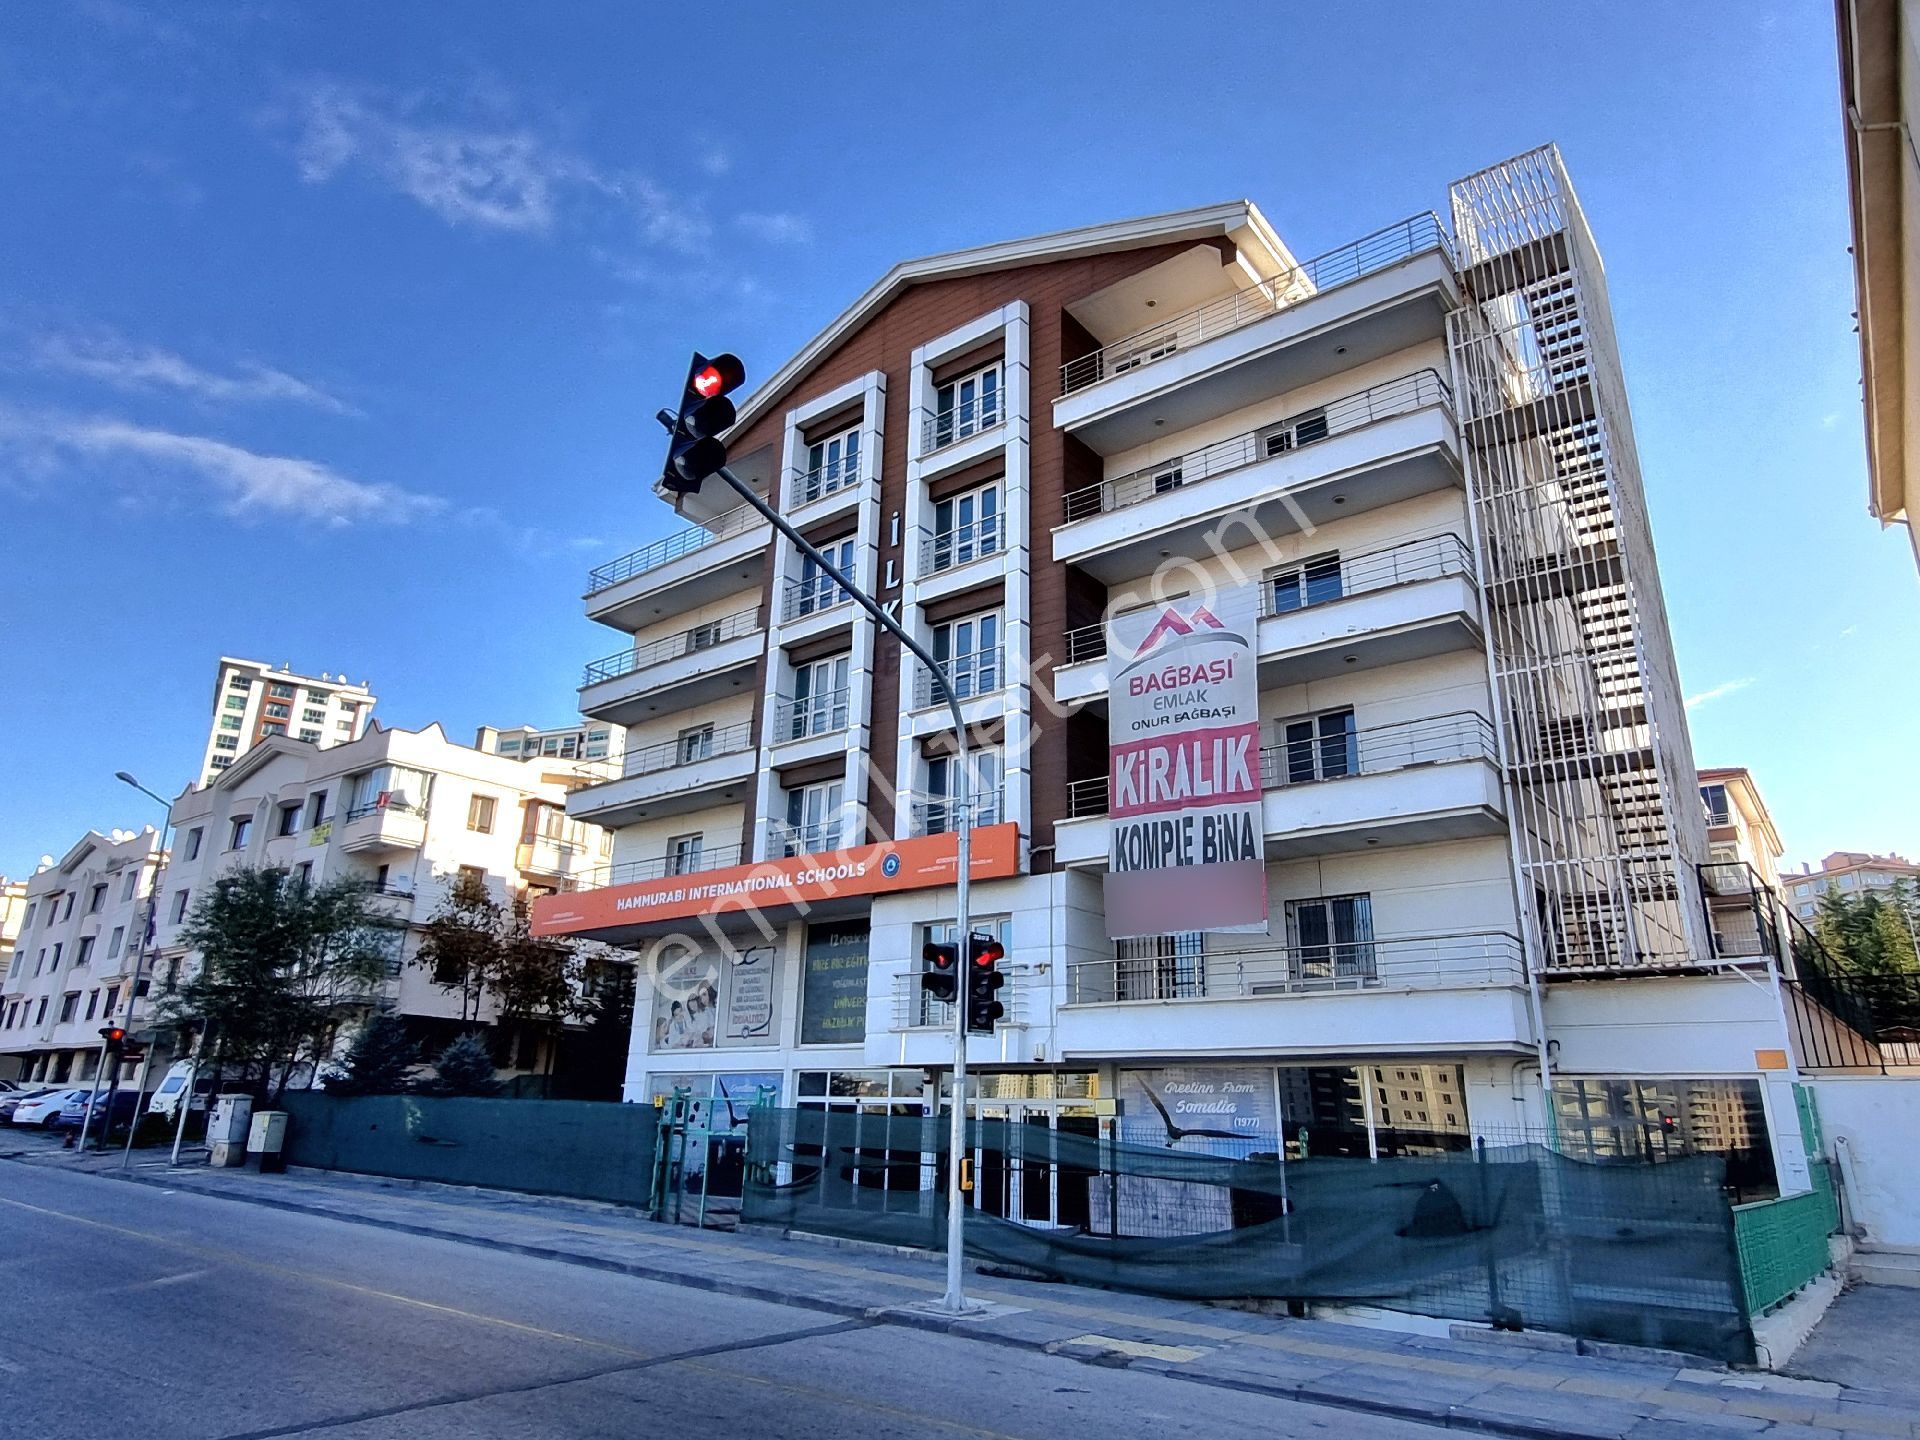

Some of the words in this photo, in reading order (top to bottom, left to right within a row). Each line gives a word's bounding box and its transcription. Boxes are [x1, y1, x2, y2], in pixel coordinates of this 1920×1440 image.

[1129, 659, 1233, 697] BAĞBAŞI
[1153, 688, 1208, 711] EMLAK
[1131, 715, 1170, 731] ONUR
[1115, 815, 1194, 873] KOMPLE
[688, 873, 793, 901] INTERNATIONAL
[796, 862, 866, 886] SCHOOLS
[1221, 1081, 1255, 1093] From
[1175, 1099, 1237, 1114] Somalia
[1234, 1117, 1260, 1128] (1977)
